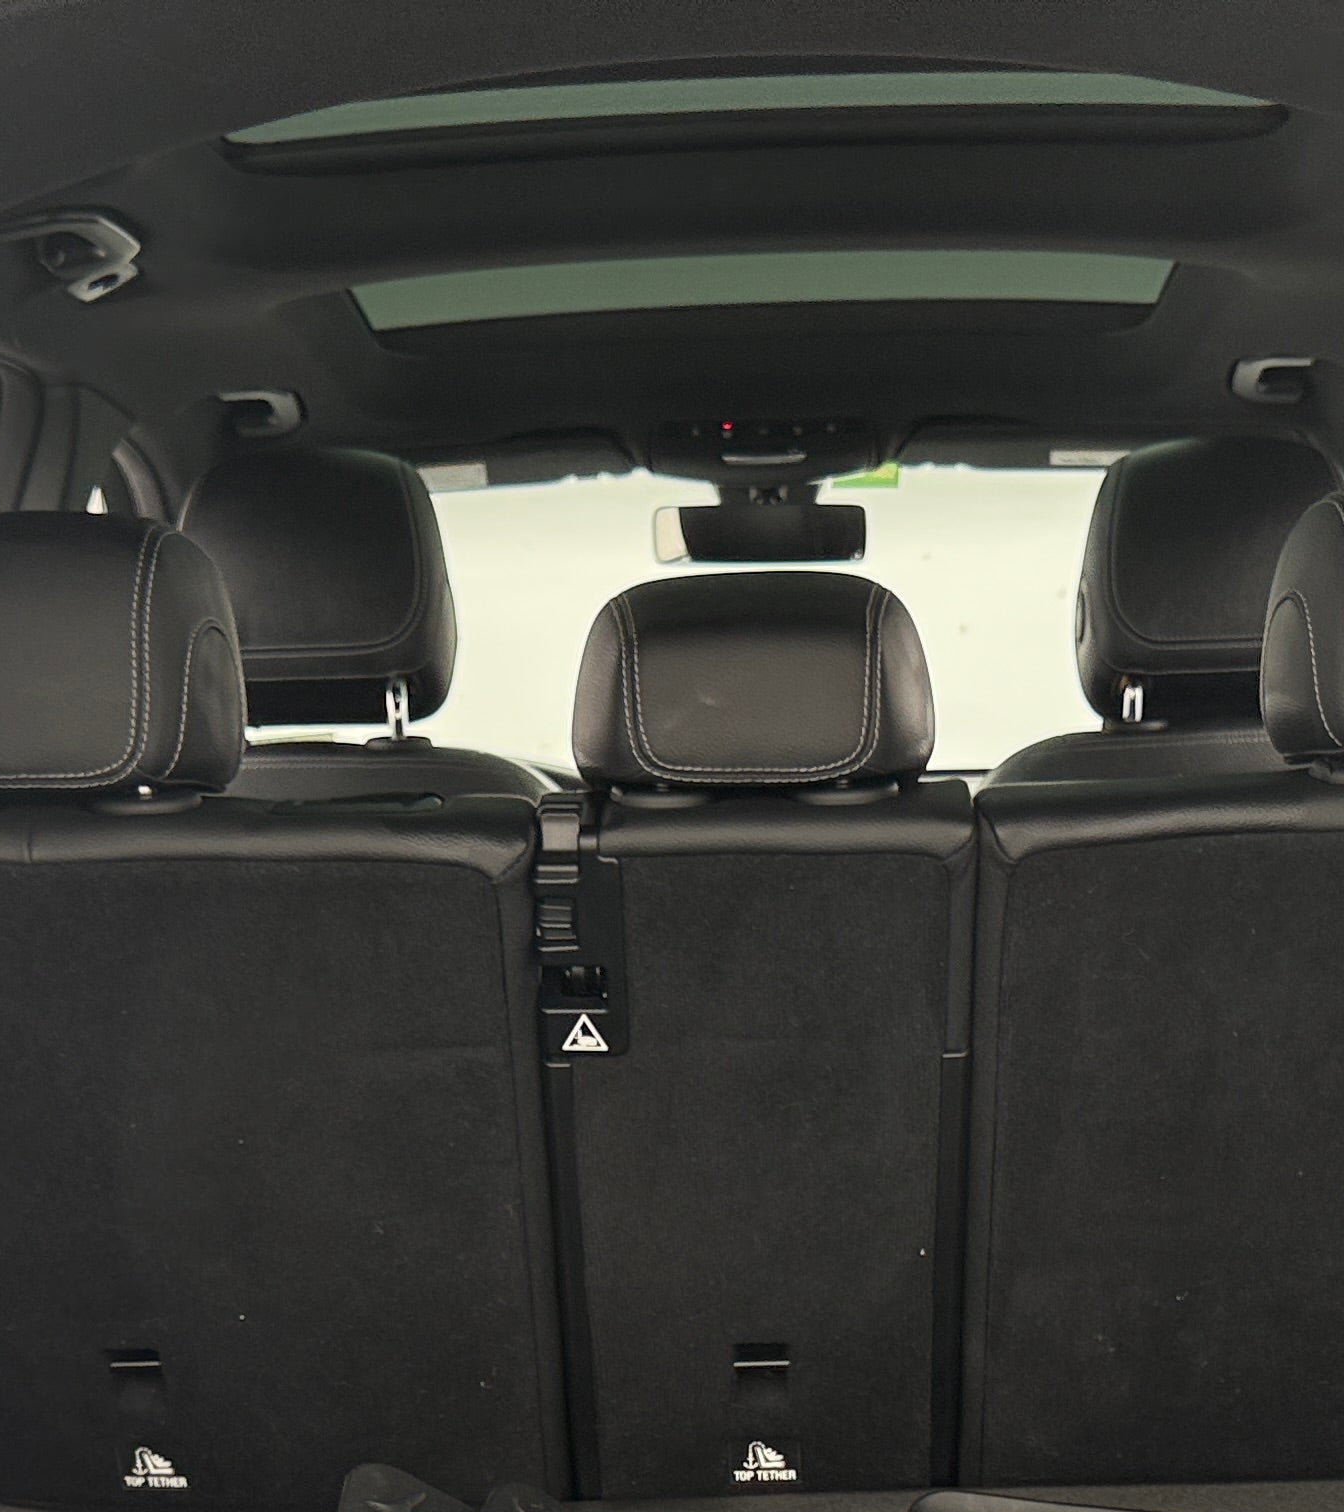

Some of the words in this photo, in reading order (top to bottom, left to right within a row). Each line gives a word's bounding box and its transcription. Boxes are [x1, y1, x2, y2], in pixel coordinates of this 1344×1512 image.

[733, 1470, 754, 1481] TOP
[756, 1469, 797, 1481] TETHER
[123, 1475, 146, 1488] TOP
[147, 1475, 188, 1488] TETHER
